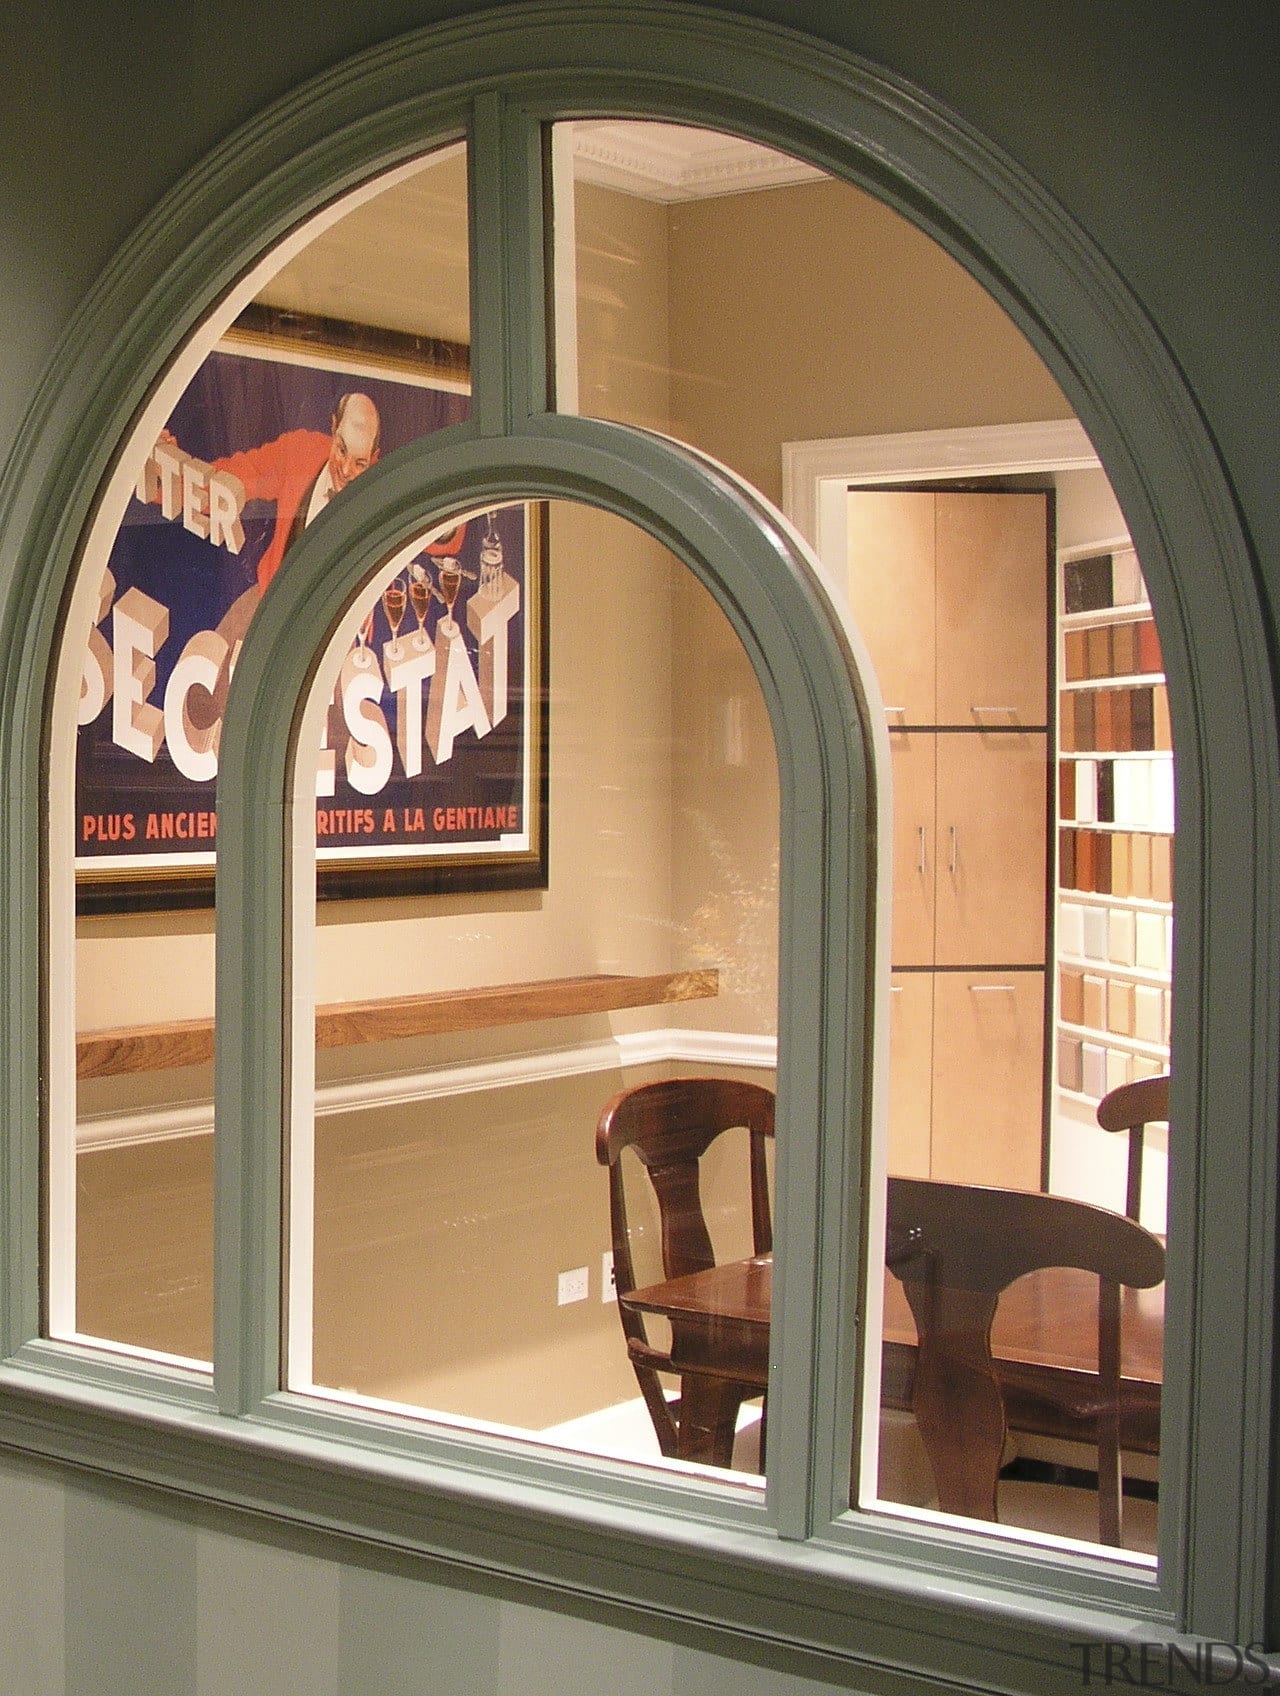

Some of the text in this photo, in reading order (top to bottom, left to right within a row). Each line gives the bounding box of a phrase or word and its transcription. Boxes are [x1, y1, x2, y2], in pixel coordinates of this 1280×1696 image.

[83, 813, 136, 841] PLUS
[383, 808, 396, 832] A
[404, 807, 426, 831] LA
[433, 806, 518, 831] GENTIANE
